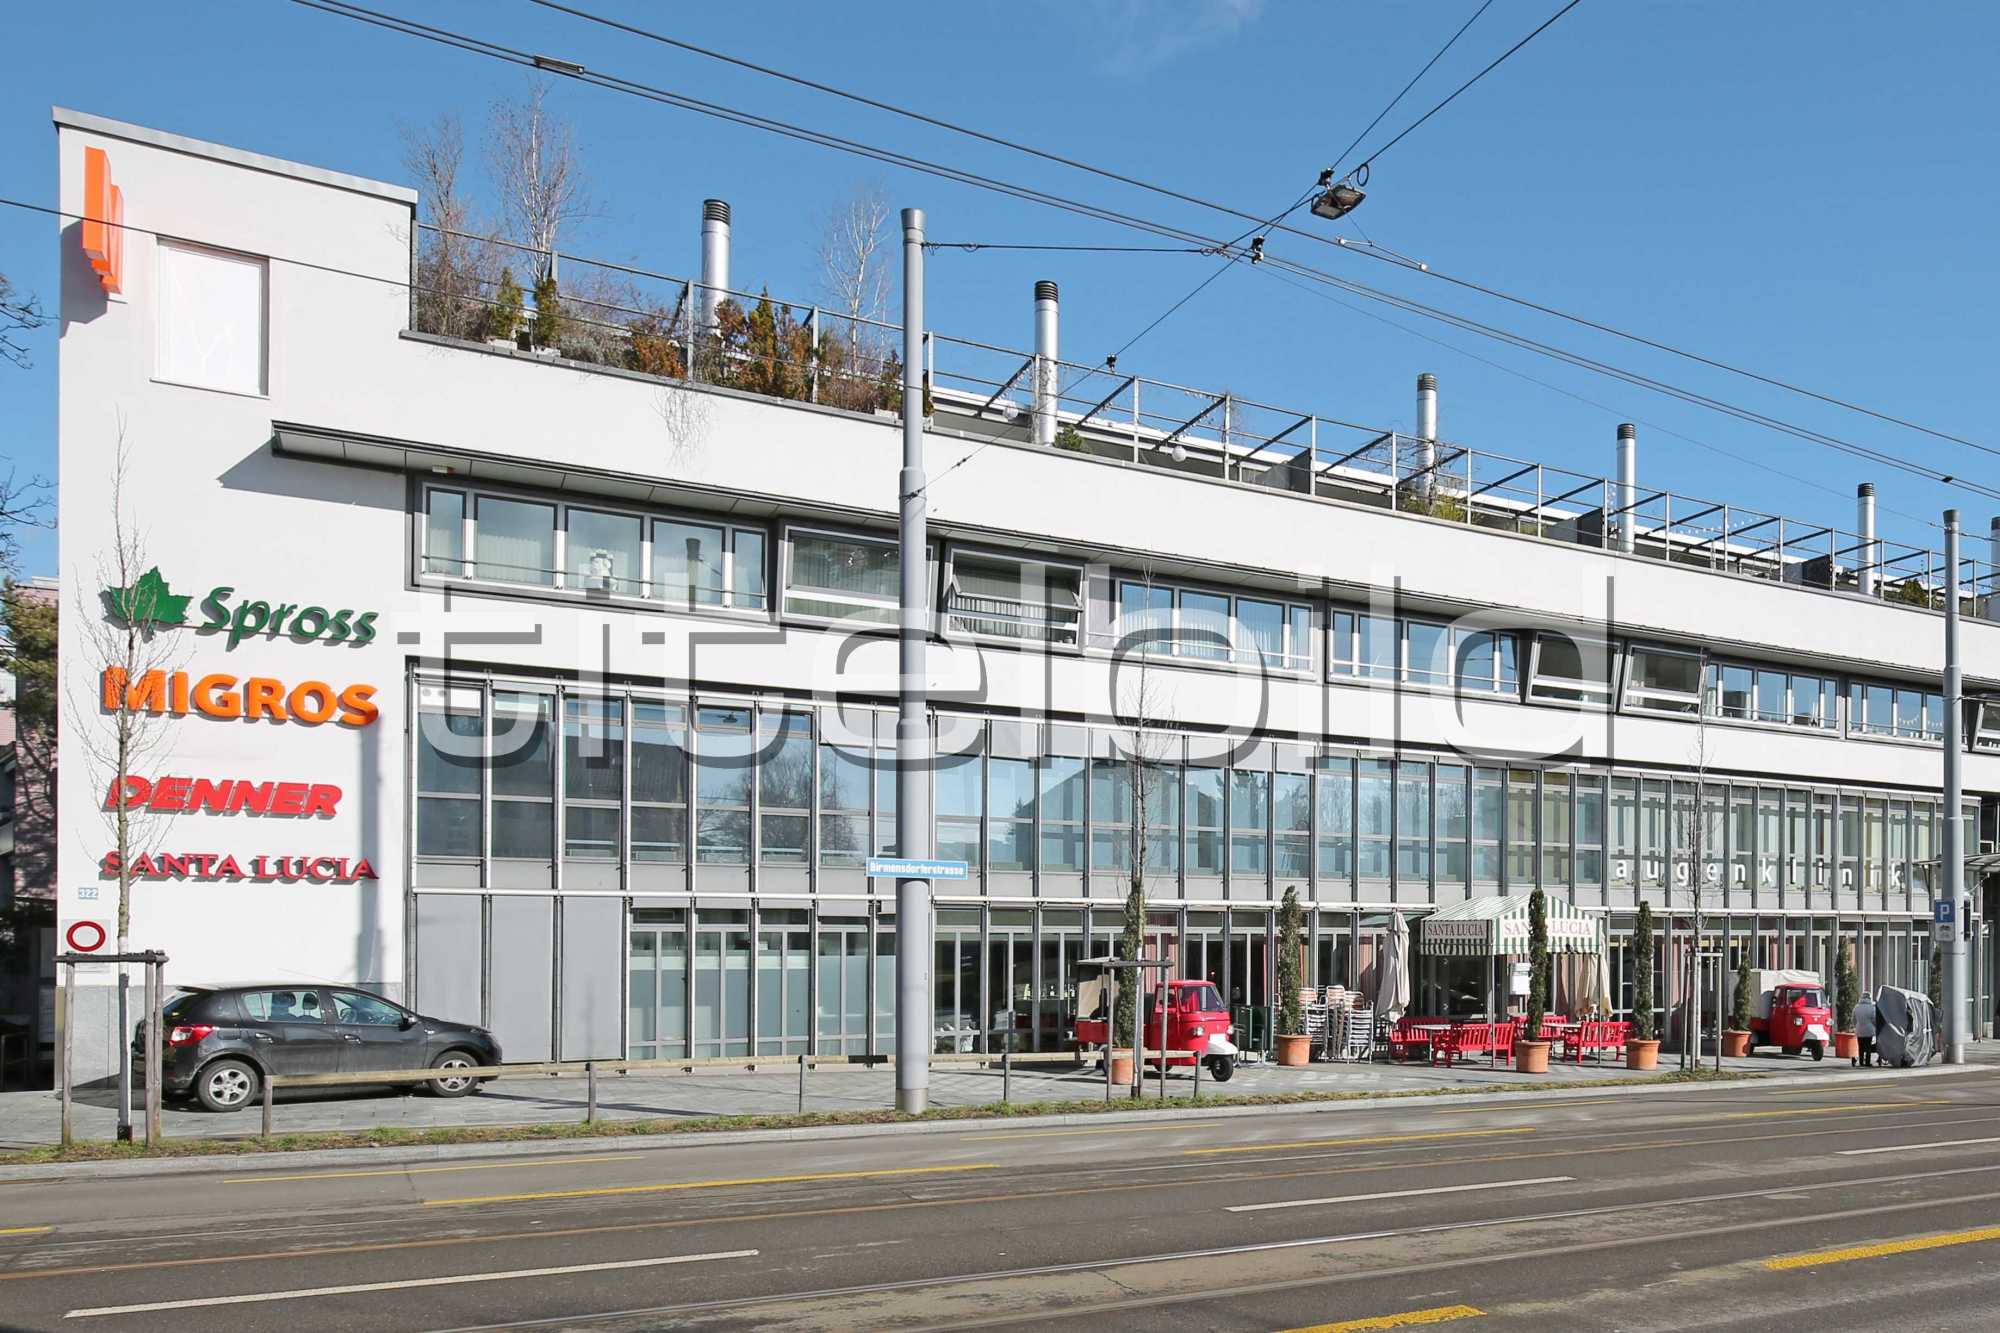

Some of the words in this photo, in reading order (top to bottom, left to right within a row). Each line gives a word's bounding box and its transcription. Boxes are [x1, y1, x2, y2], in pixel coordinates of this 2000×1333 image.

[200, 587, 379, 648] Spross
[103, 666, 379, 725] MIGROS
[104, 775, 343, 817] DENNER
[104, 850, 247, 878] SANTA
[255, 855, 380, 881] LUCIA
[870, 862, 964, 875] Birmensdorferstrasse
[1615, 857, 1902, 887] augenklinik
[79, 888, 97, 899] 322
[1940, 904, 1950, 921] P
[1427, 920, 1455, 935] SANTA
[1456, 920, 1484, 936] LUCIA
[1552, 921, 1591, 936] LUCIA
